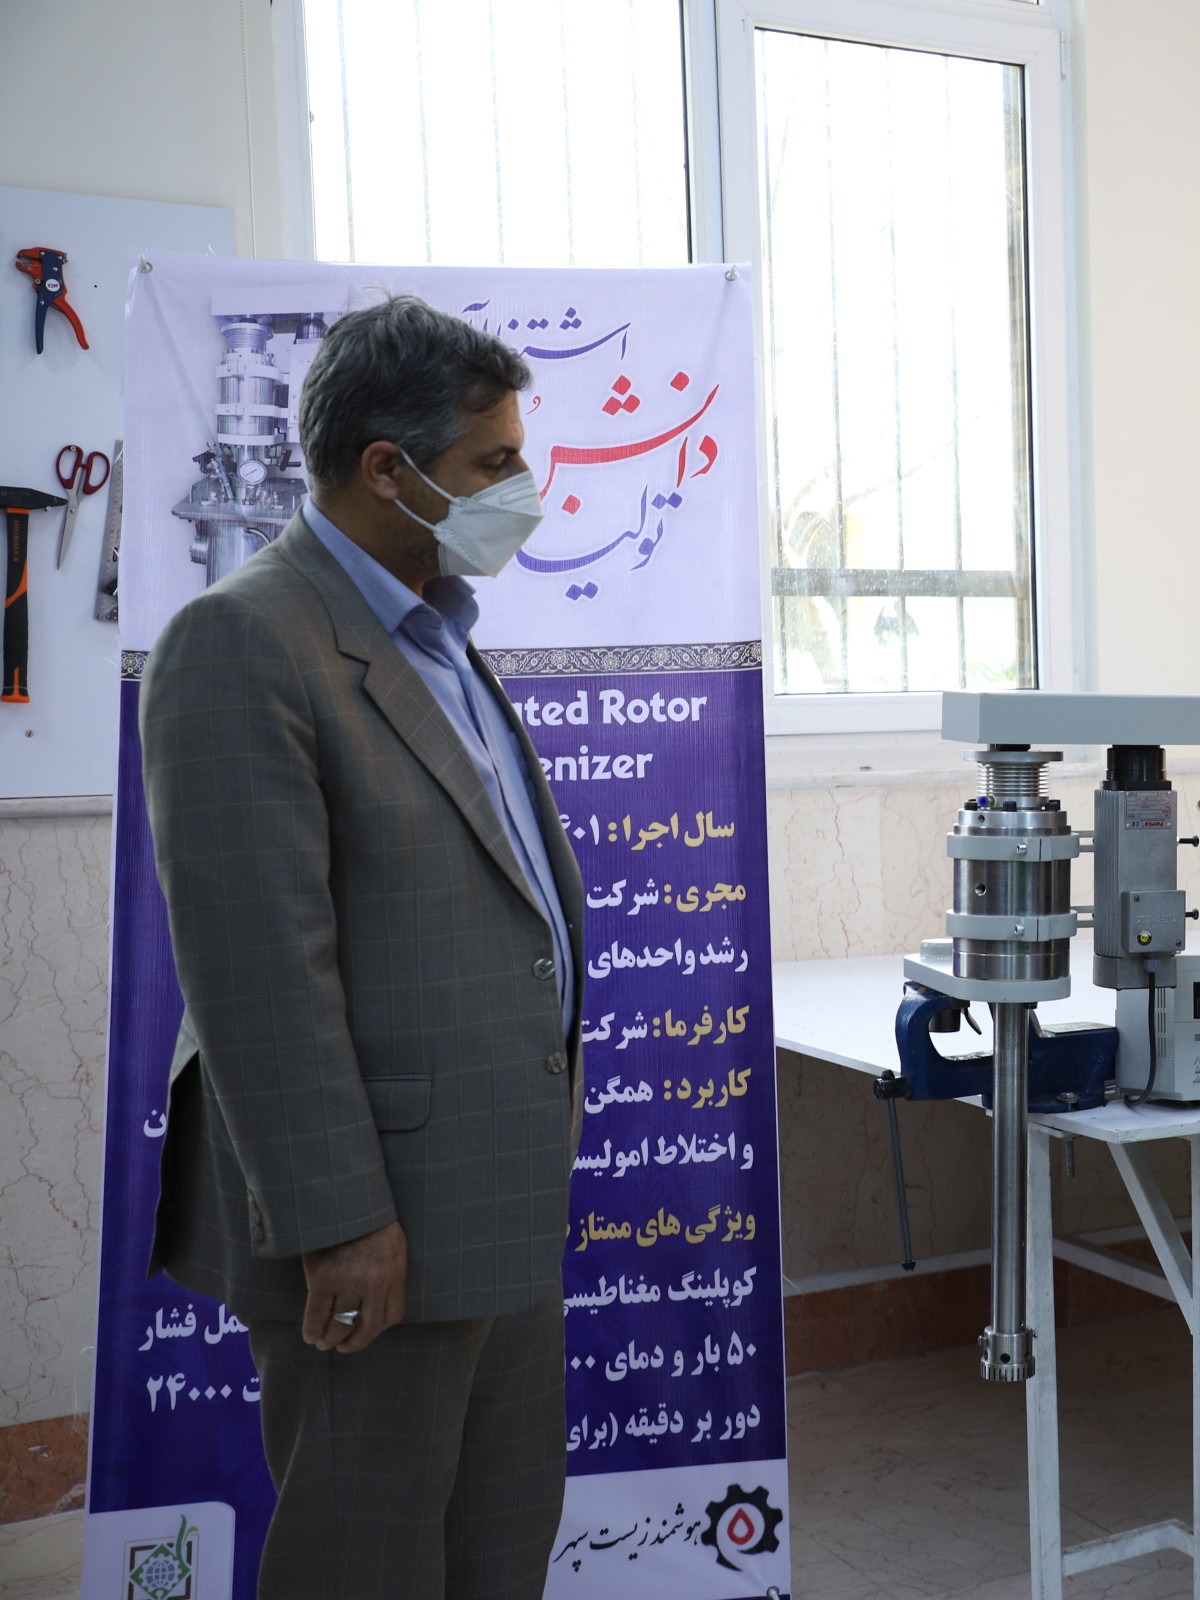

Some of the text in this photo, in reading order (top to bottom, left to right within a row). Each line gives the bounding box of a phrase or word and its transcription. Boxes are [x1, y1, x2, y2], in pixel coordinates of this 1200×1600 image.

[515, 484, 683, 601] تولی
[599, 689, 708, 726] Rotor
[538, 745, 653, 781] enizer
[684, 810, 735, 847] سال
[585, 878, 659, 916] شرکت
[587, 936, 749, 979] رشد واحدهای
[581, 1010, 648, 1050] شرکت
[584, 1075, 653, 1114] همگن
[569, 1136, 649, 1178] امولیس
[653, 1131, 736, 1166] اختلاط
[574, 1204, 756, 1252] ویژگی های ممتاز
[667, 1266, 757, 1308] کوپلینگ
[138, 1303, 197, 1351] فشار
[605, 1340, 665, 1382] دمای
[690, 1334, 720, 1376] بار
[624, 1402, 684, 1444] دقیقه
[690, 1410, 712, 1443] بر
[719, 1404, 761, 1441] دور
